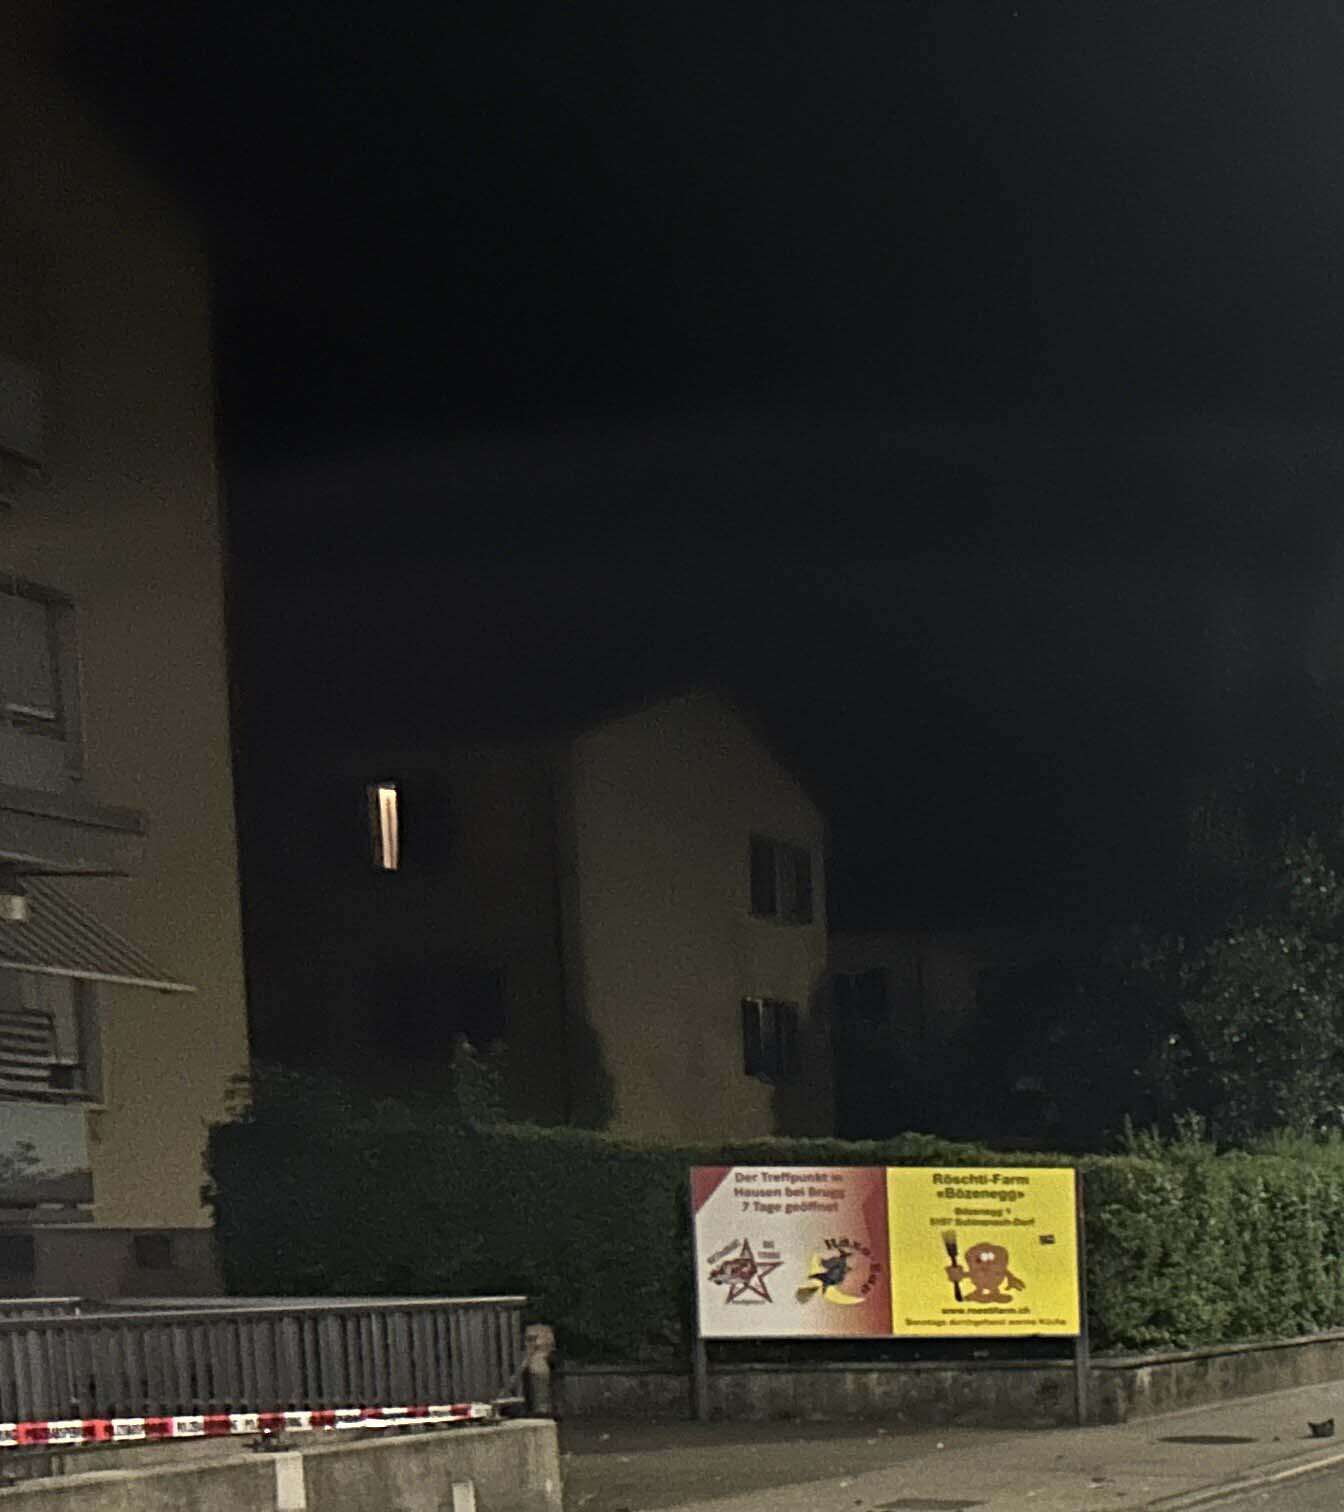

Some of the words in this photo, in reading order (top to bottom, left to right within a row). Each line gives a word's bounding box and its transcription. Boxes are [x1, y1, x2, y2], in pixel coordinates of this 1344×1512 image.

[735, 1172, 758, 1182] Der
[761, 1172, 828, 1184] Treffpunkt
[932, 1173, 1030, 1185] Röschti-Farm
[734, 1187, 782, 1197] Hausen
[808, 1186, 845, 1199] Brugg
[936, 1187, 1025, 1201] «Bözenegg»
[753, 1202, 782, 1213] Tage
[785, 1202, 839, 1214] geöffnet
